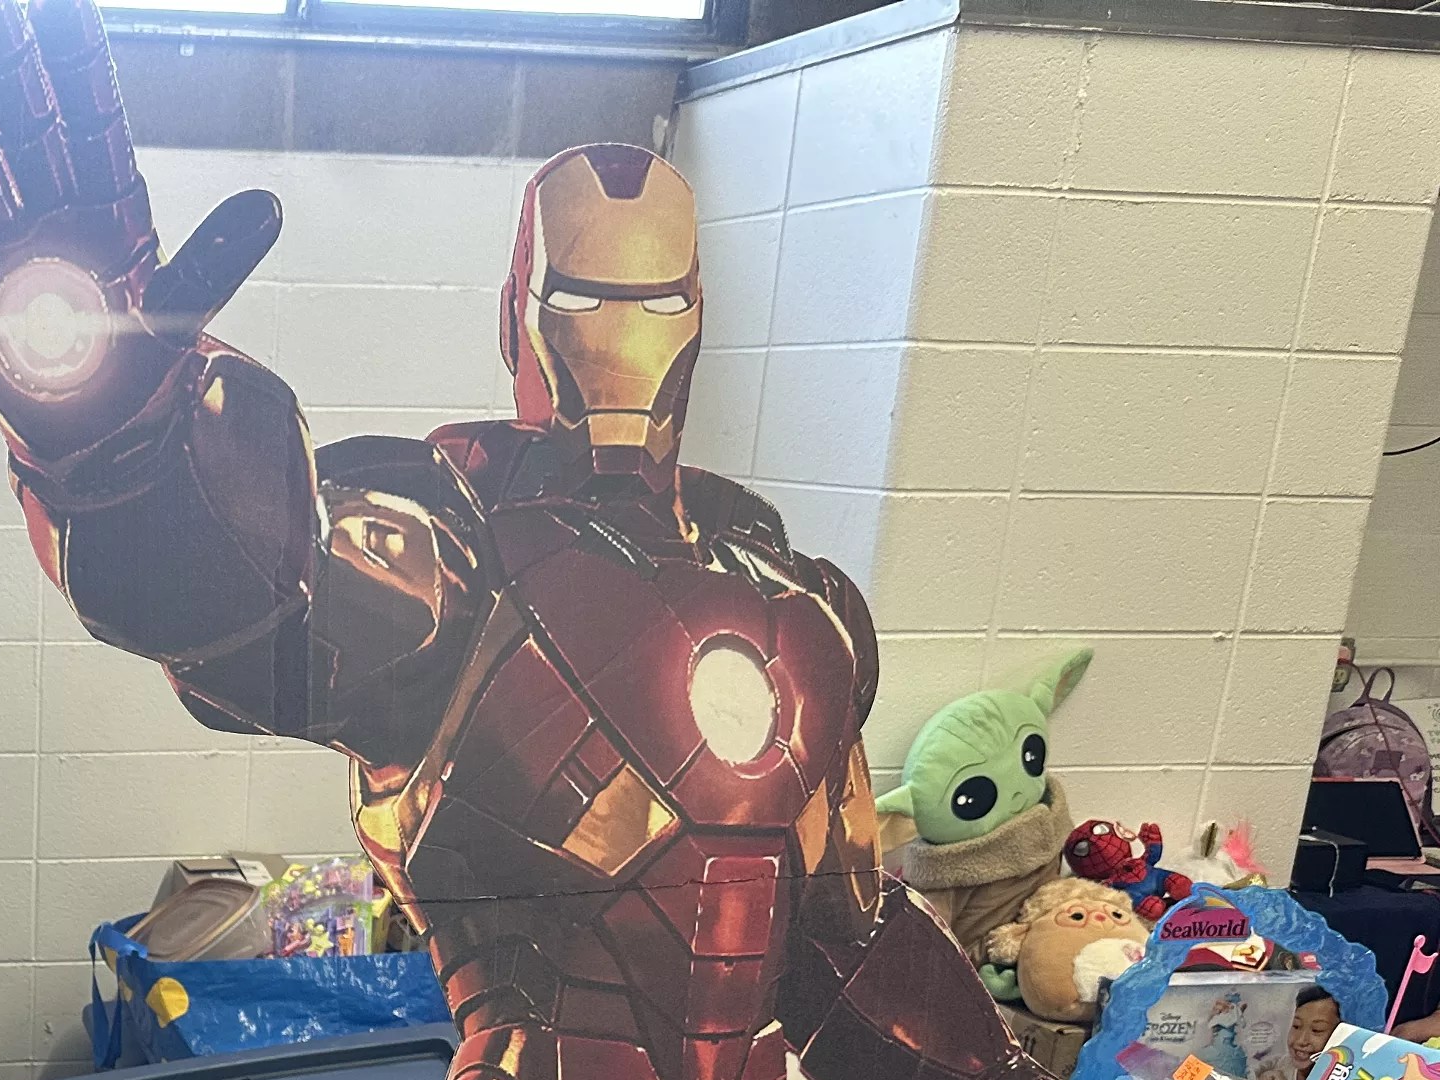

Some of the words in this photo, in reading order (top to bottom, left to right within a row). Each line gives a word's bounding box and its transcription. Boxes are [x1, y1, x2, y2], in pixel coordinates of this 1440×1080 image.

[1160, 918, 1246, 940] SeaWorld
[1160, 1012, 1182, 1021] Disney
[1143, 1020, 1197, 1036] FROZEN
